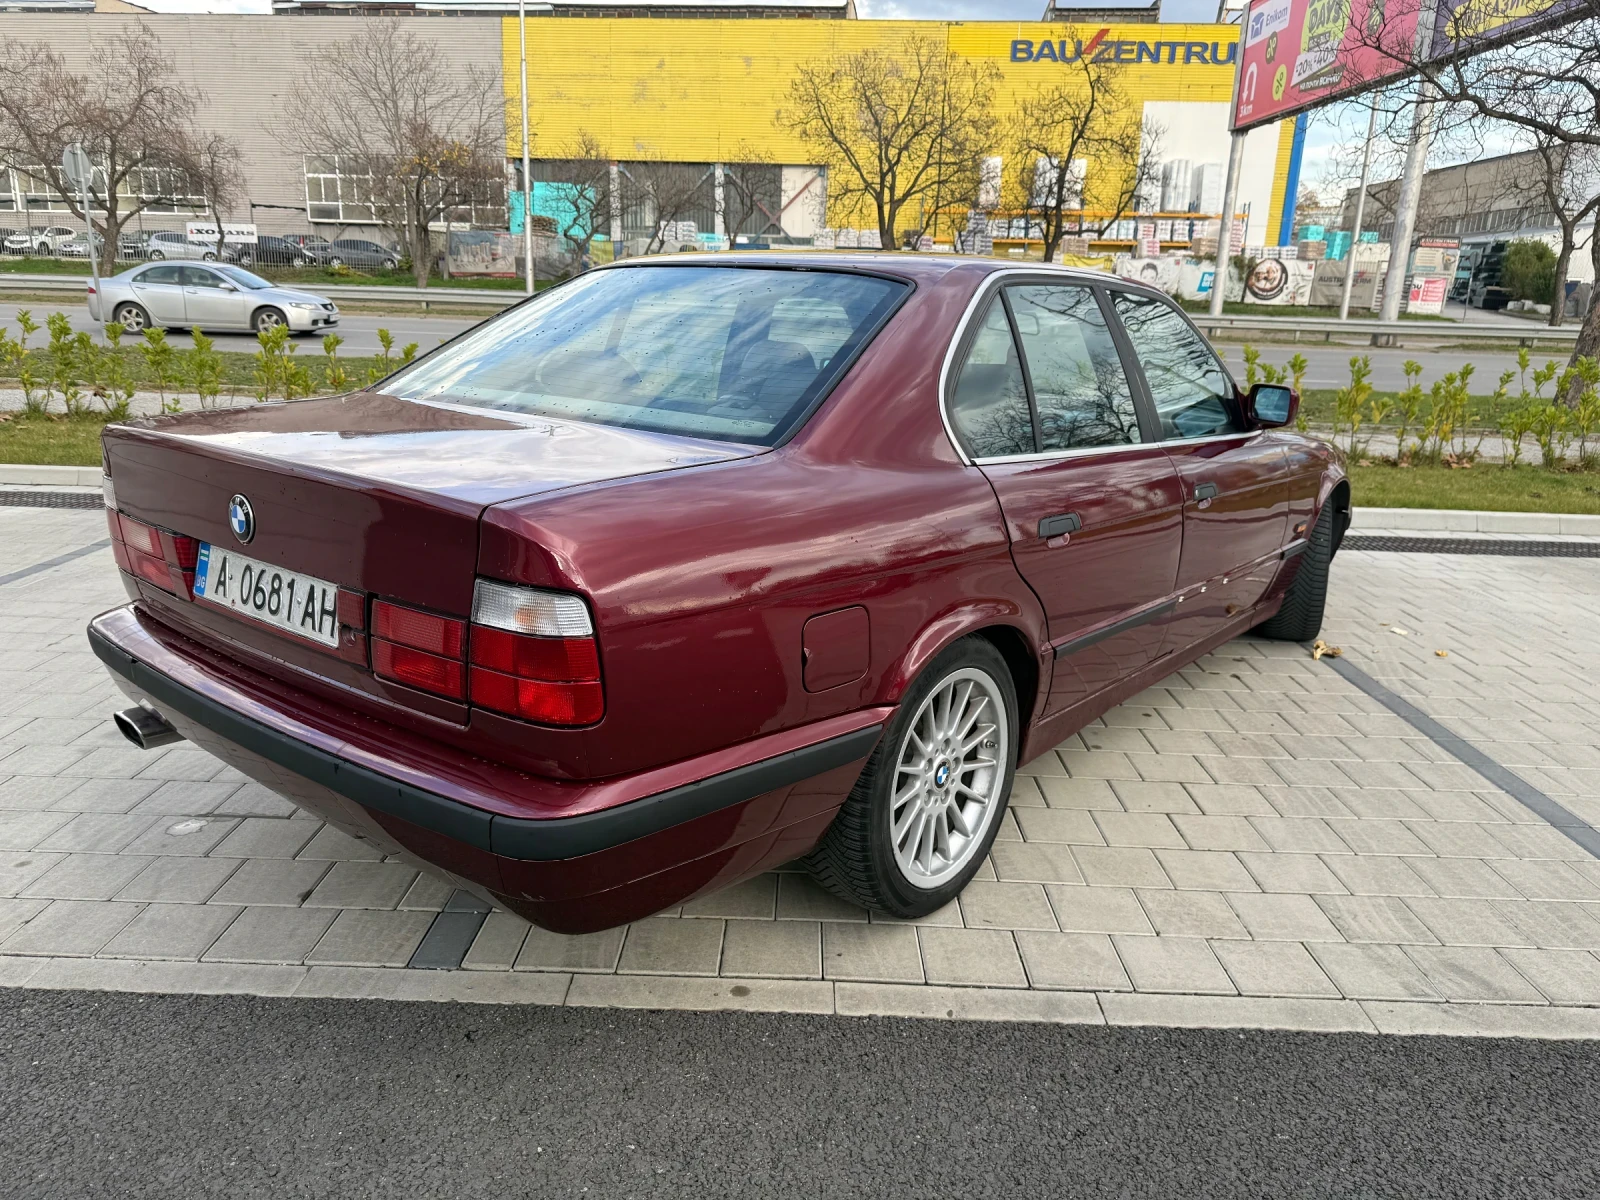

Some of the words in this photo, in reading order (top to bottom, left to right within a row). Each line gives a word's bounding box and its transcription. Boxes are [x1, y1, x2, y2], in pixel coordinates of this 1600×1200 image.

[196, 574, 206, 589] BG
[214, 556, 229, 598] A
[240, 564, 296, 623] 0681
[301, 584, 337, 638] AH
